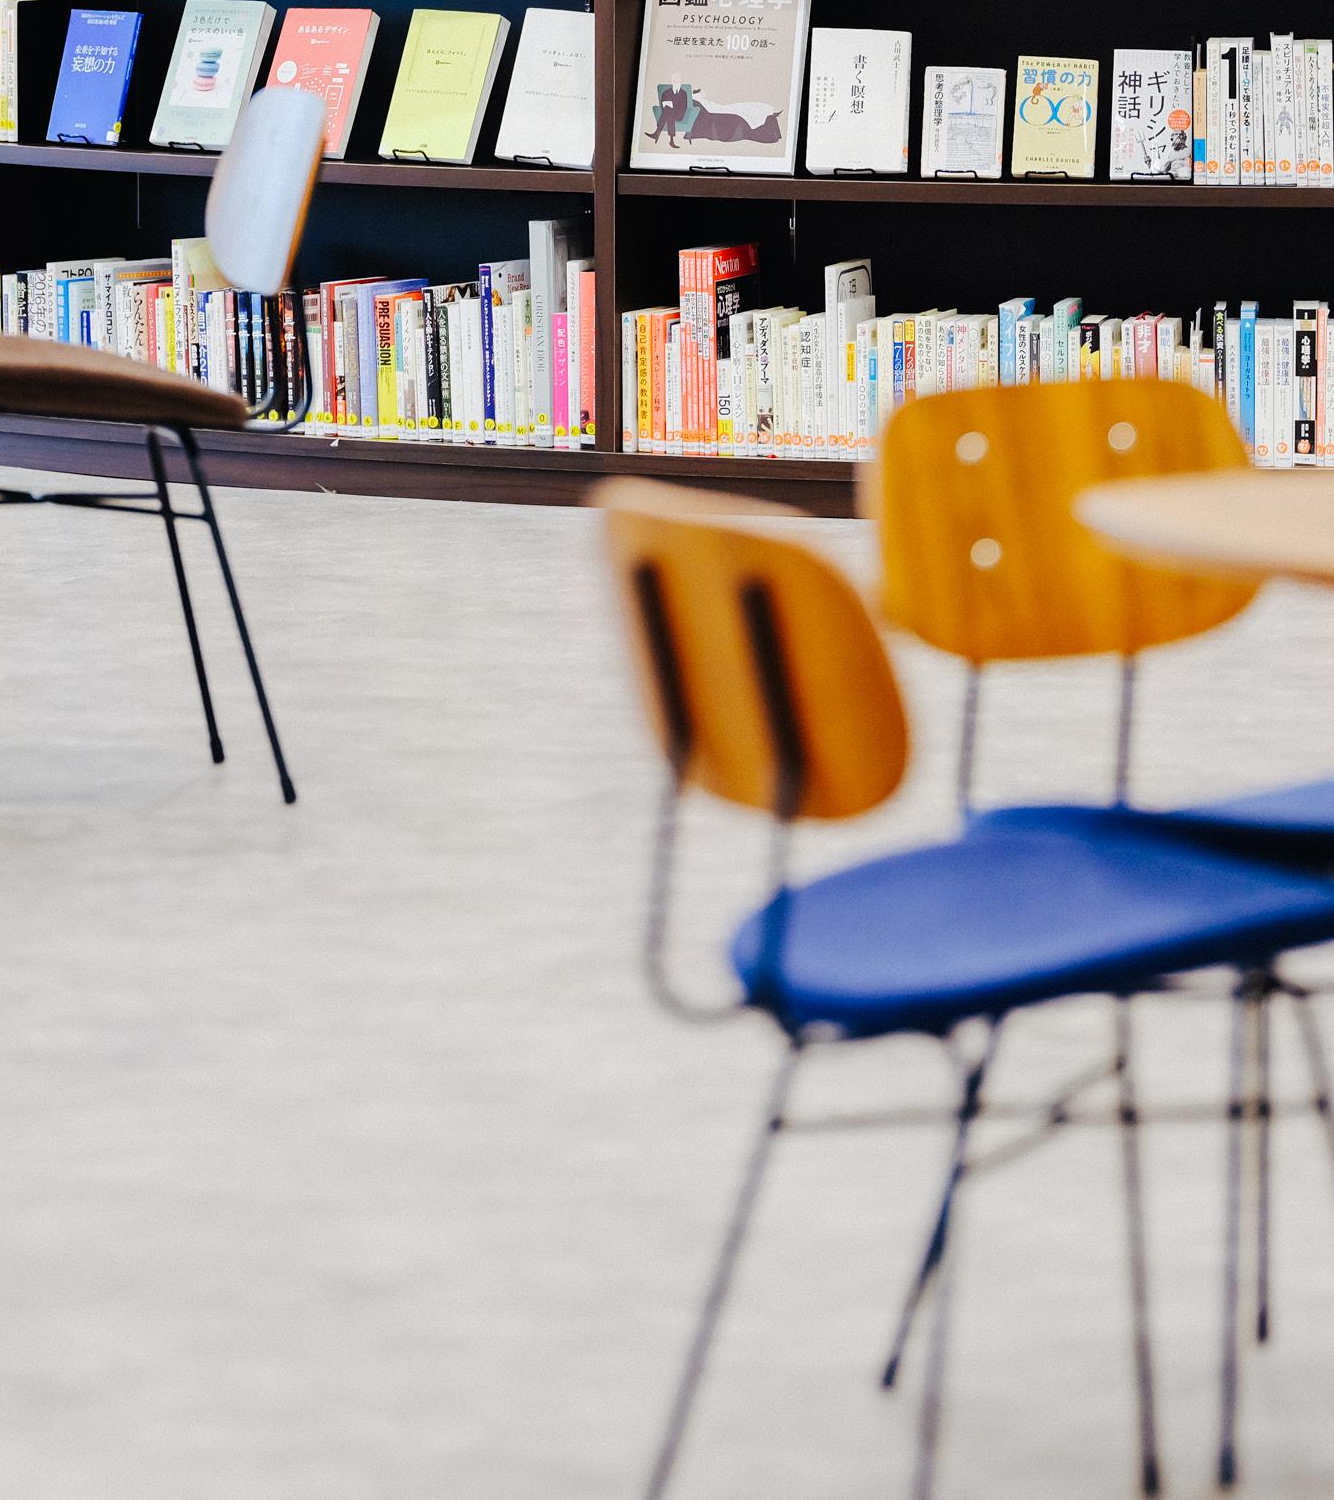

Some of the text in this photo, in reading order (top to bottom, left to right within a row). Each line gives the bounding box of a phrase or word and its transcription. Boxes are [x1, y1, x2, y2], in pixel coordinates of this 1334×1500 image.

[683, 15, 764, 25] PSYCHOLOGY
[72, 57, 116, 74] 妄想の力
[851, 54, 867, 114] 書く瞑想
[1023, 69, 1092, 86] 習慣の力
[1118, 70, 1142, 119] 神話
[715, 257, 739, 276] Newton
